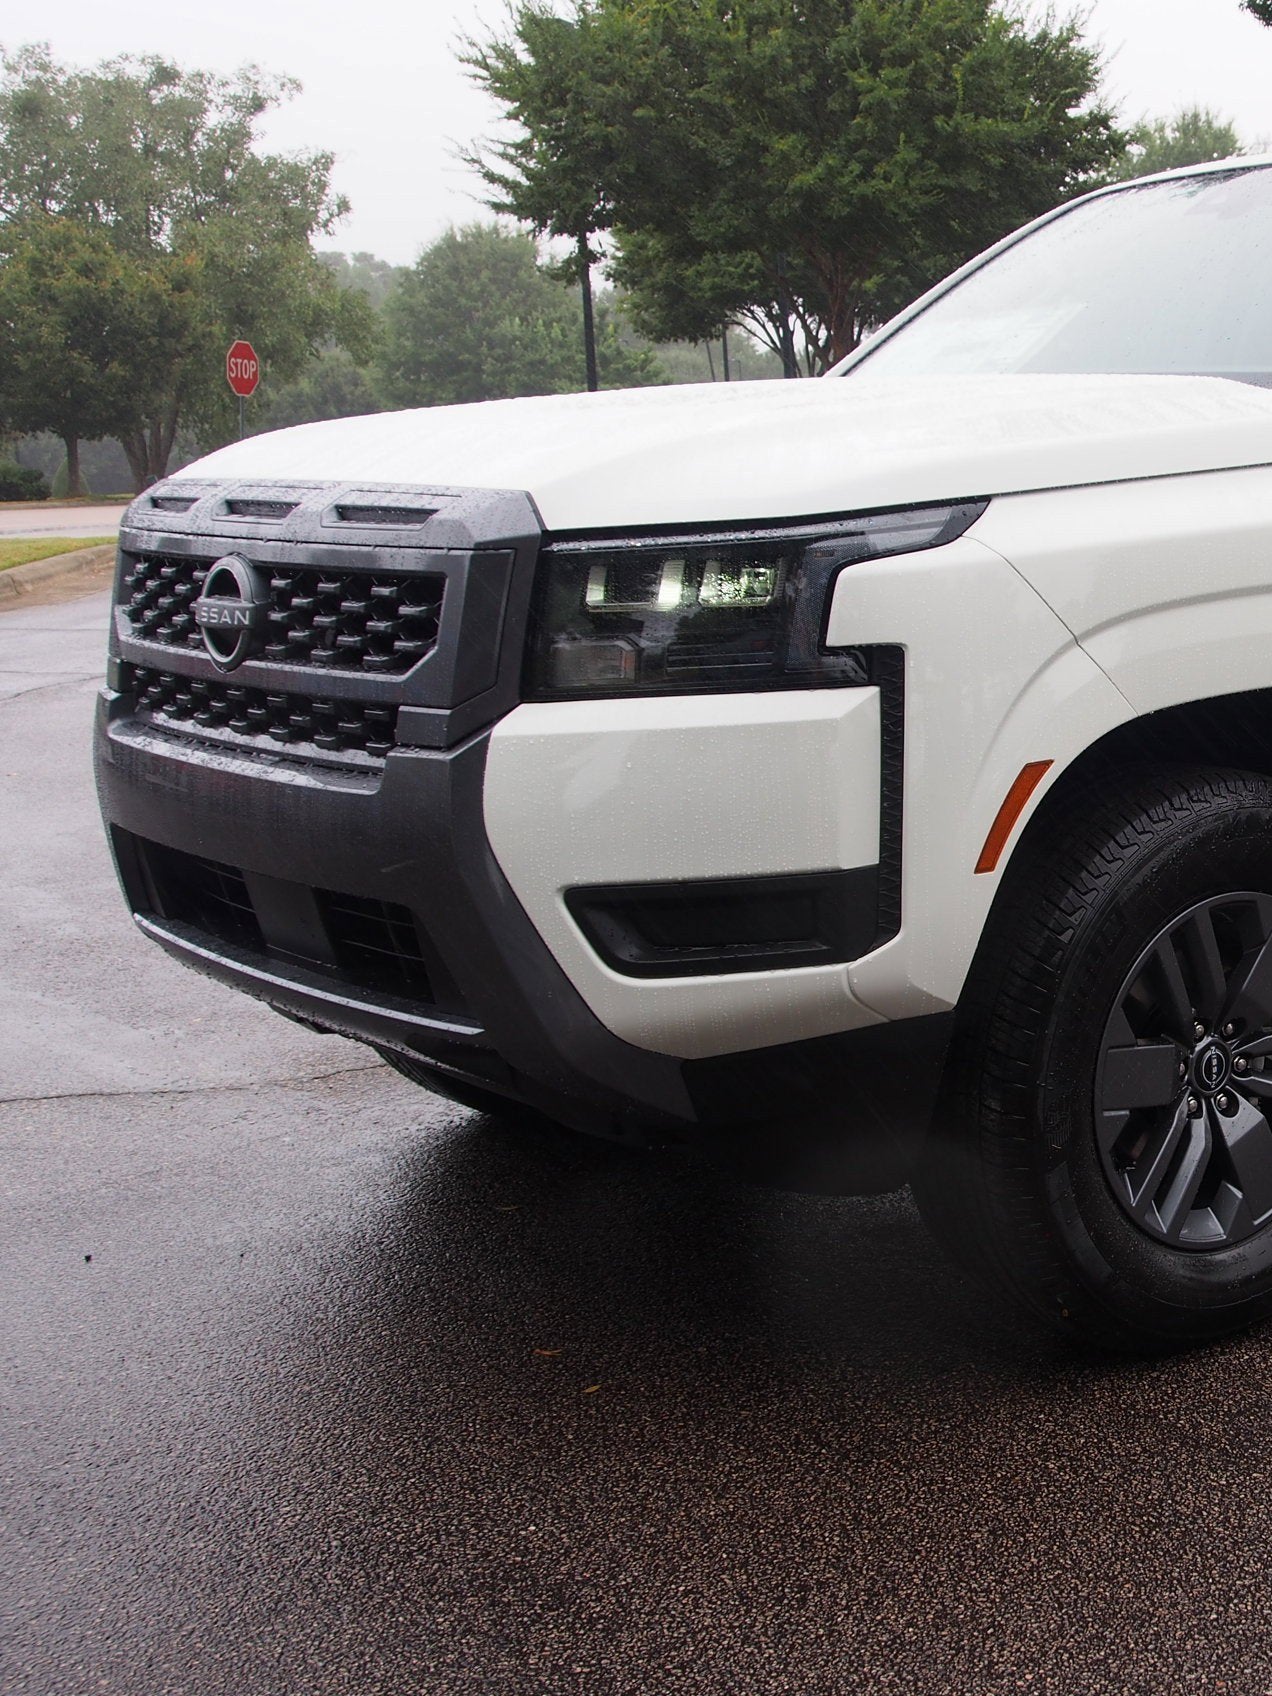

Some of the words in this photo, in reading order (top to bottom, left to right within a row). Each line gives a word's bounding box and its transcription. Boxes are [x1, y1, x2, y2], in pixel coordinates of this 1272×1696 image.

[229, 357, 257, 379] STOP
[199, 606, 250, 625] SSAN
[1210, 1045, 1218, 1089] NISSAN
